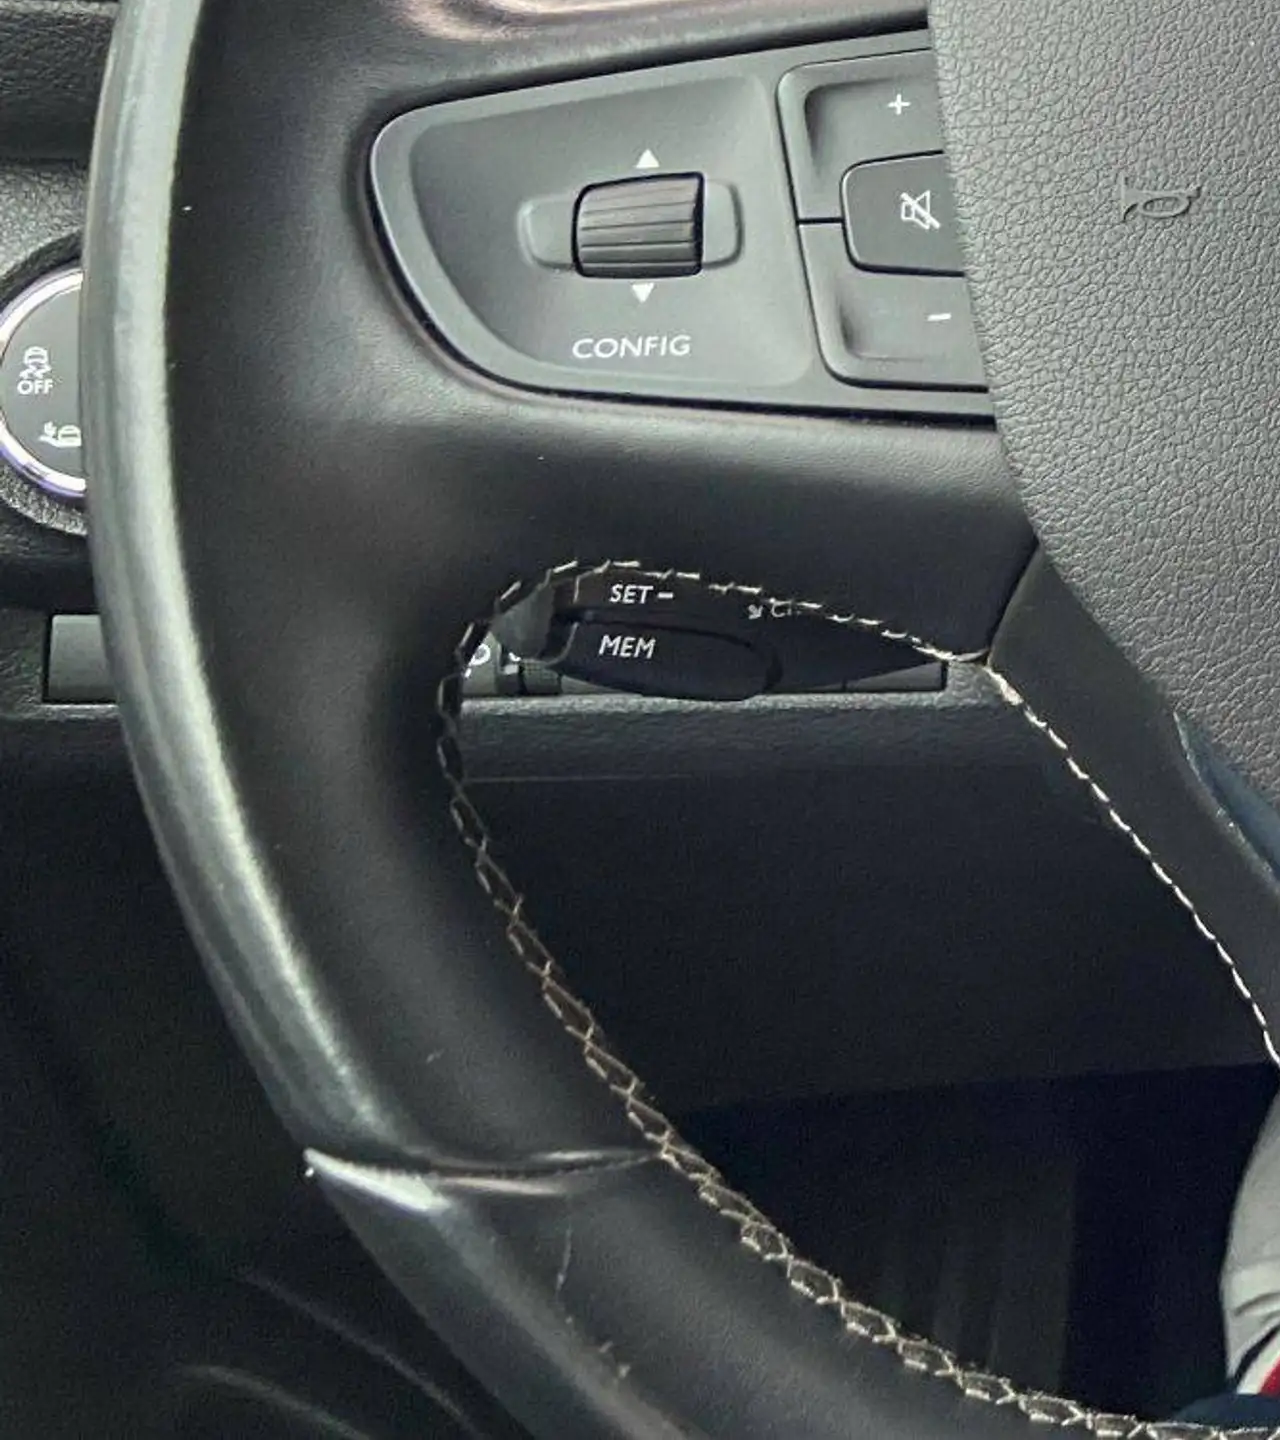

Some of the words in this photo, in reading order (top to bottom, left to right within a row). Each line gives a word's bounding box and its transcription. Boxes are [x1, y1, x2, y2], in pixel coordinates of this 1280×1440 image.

[572, 334, 692, 359] CONFIG
[17, 379, 54, 395] OFF
[599, 634, 656, 660] MEM
